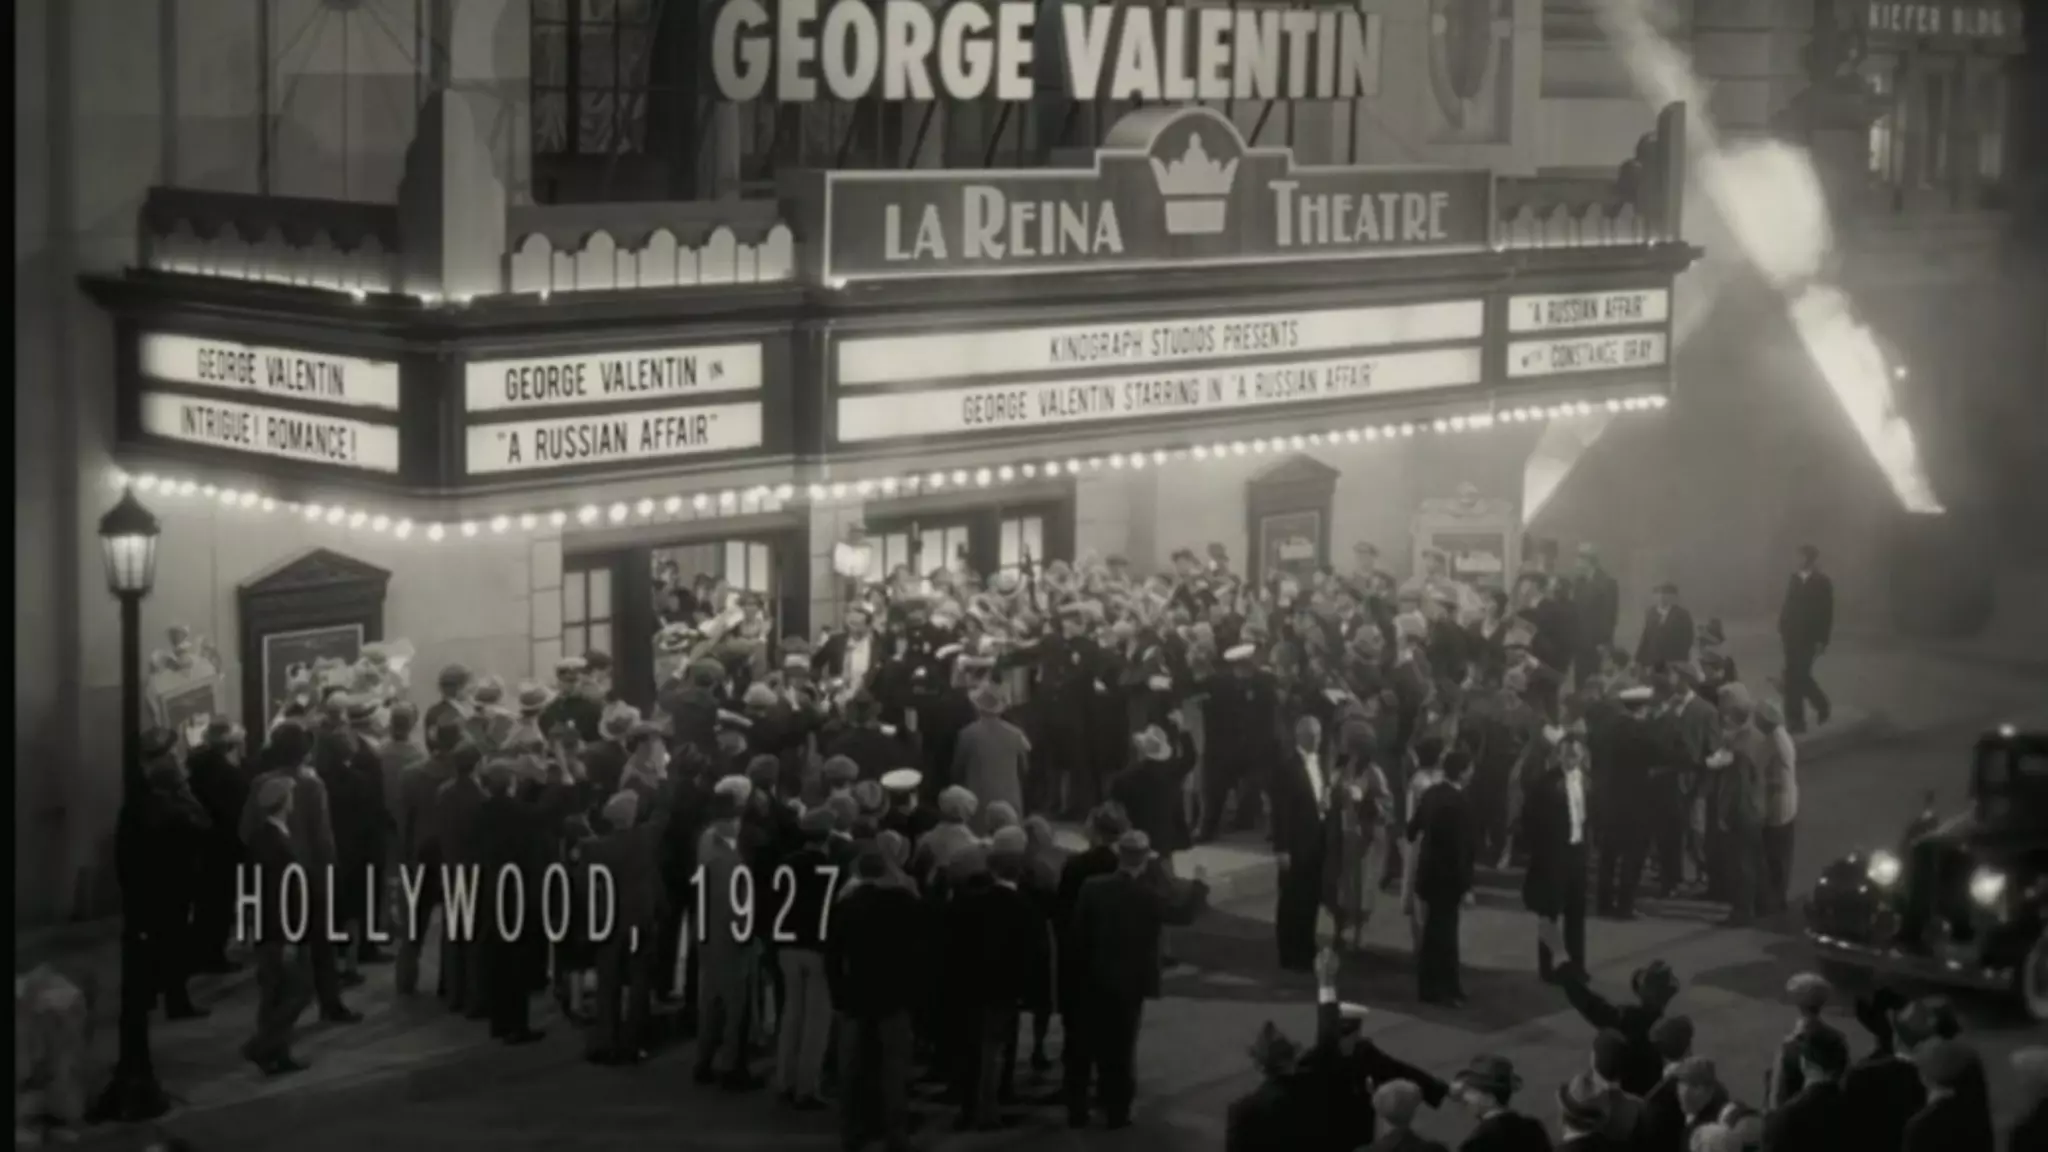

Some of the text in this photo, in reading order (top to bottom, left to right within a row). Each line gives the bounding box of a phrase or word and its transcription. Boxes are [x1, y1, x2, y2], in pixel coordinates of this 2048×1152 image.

[711, 0, 1380, 101] GEORGE VALENTIN
[885, 180, 1449, 260] LA REINA THEATRE
[1050, 319, 1299, 361] KINOGRAPH STUDIOS PRESENTS
[198, 348, 345, 395] GEORGE VALENTIN
[505, 362, 587, 401] GEORGE
[599, 355, 697, 393] VALENTIN
[962, 391, 1027, 424] GEORGE
[1038, 384, 1116, 417] VALENTIN
[1124, 378, 1199, 411] STARRING
[1206, 377, 1222, 401] IN
[1255, 369, 1318, 398] RUSSIAN
[266, 416, 357, 461] ROMANCE!
[535, 421, 628, 461] RUSSIAN
